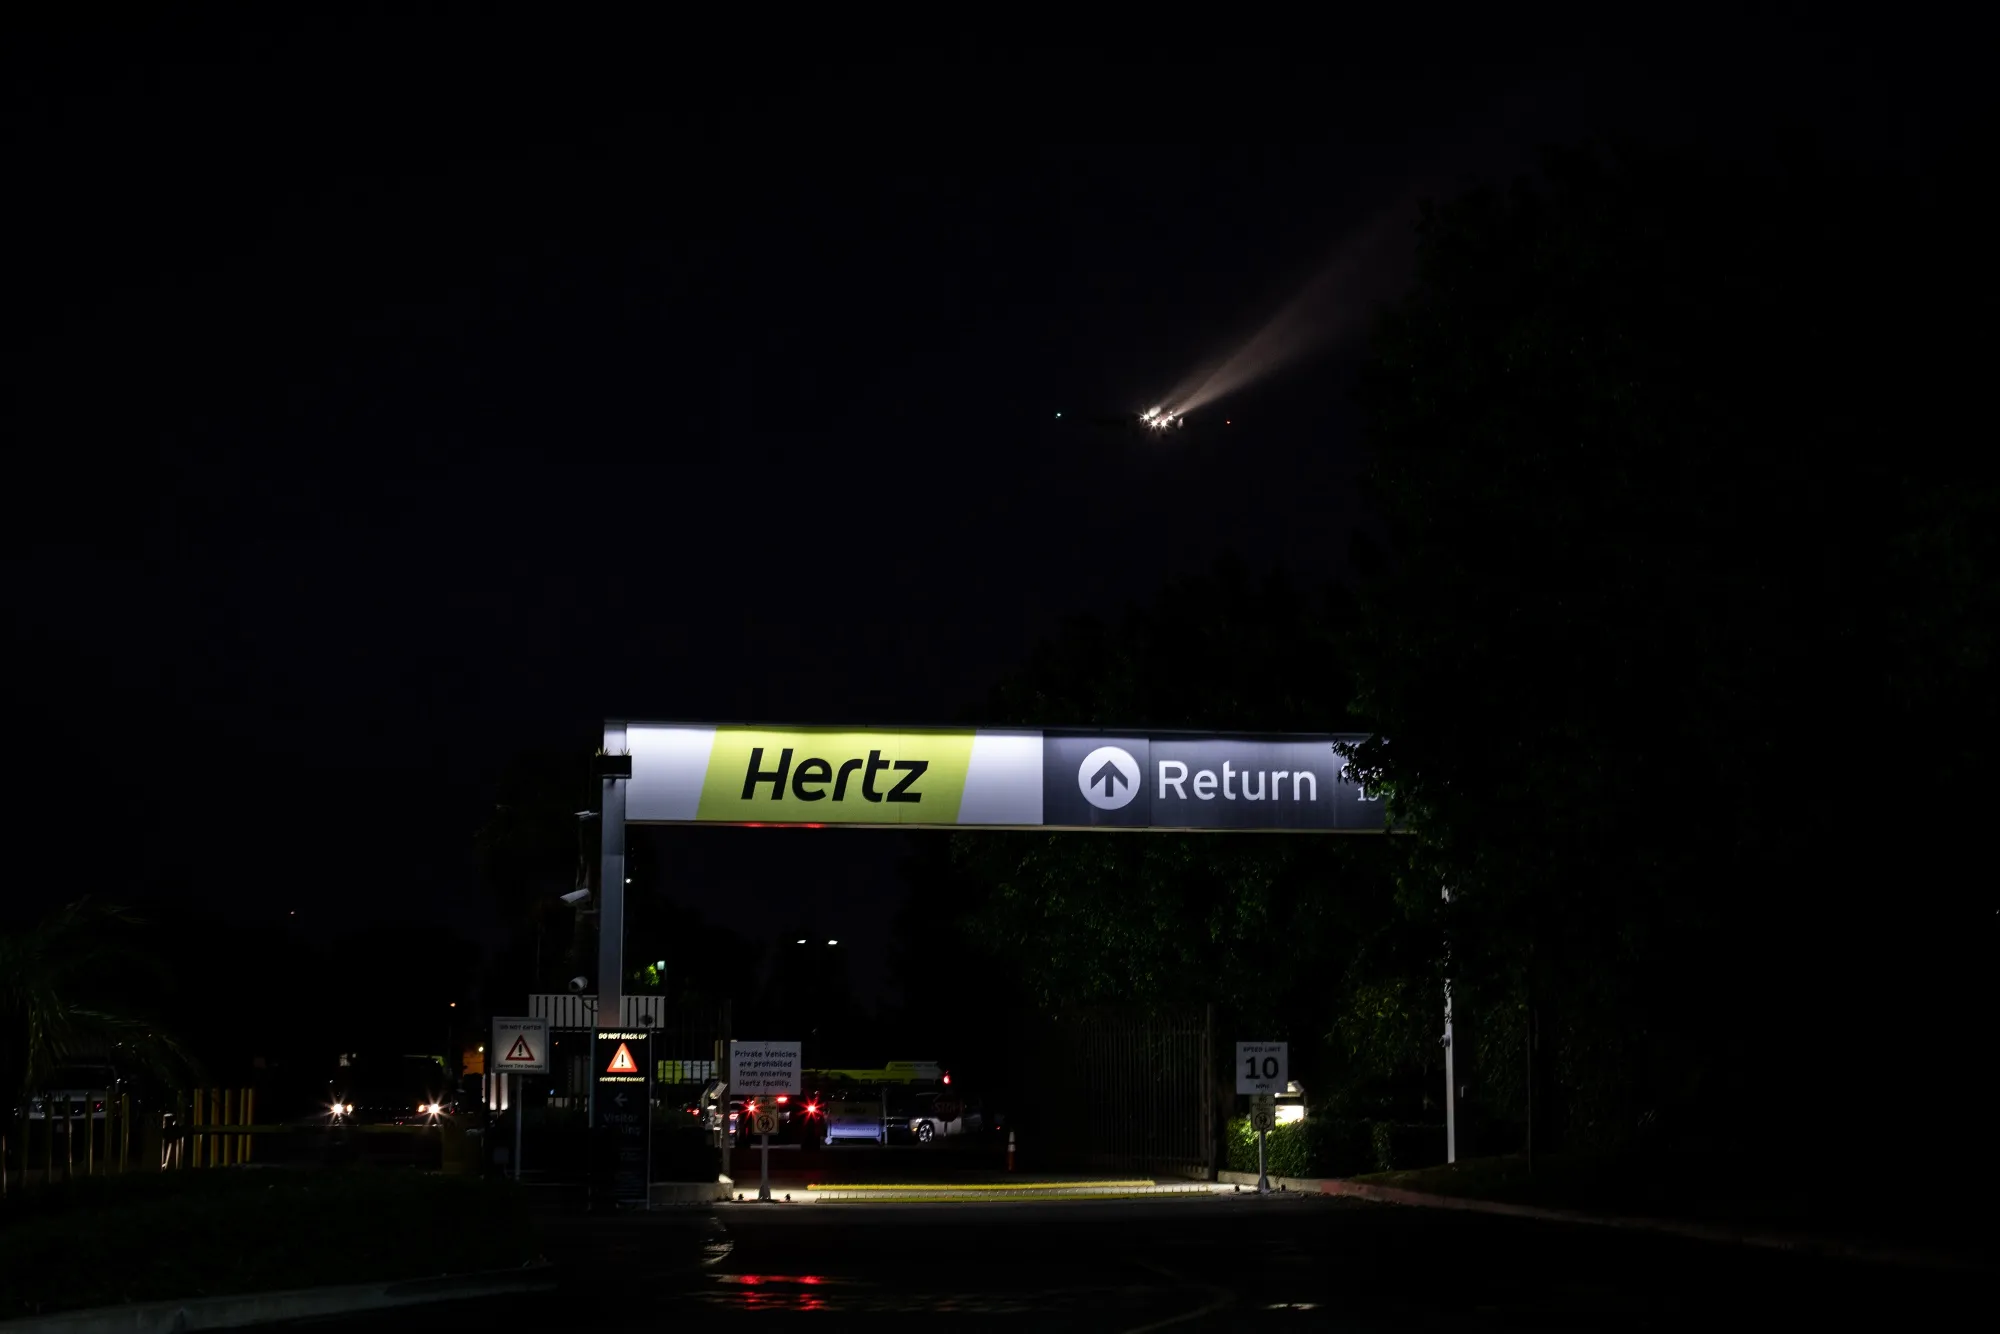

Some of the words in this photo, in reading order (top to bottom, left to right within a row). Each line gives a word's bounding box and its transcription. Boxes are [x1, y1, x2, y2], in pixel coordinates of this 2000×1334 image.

[741, 748, 929, 803] Hertz
[1158, 760, 1317, 801] Return
[735, 1050, 762, 1058] Private
[765, 1050, 797, 1058] Vehicles
[754, 1060, 792, 1069] prohibited
[1245, 1056, 1279, 1079] 10
[760, 1070, 792, 1078] entering
[762, 1080, 792, 1089] facility.
